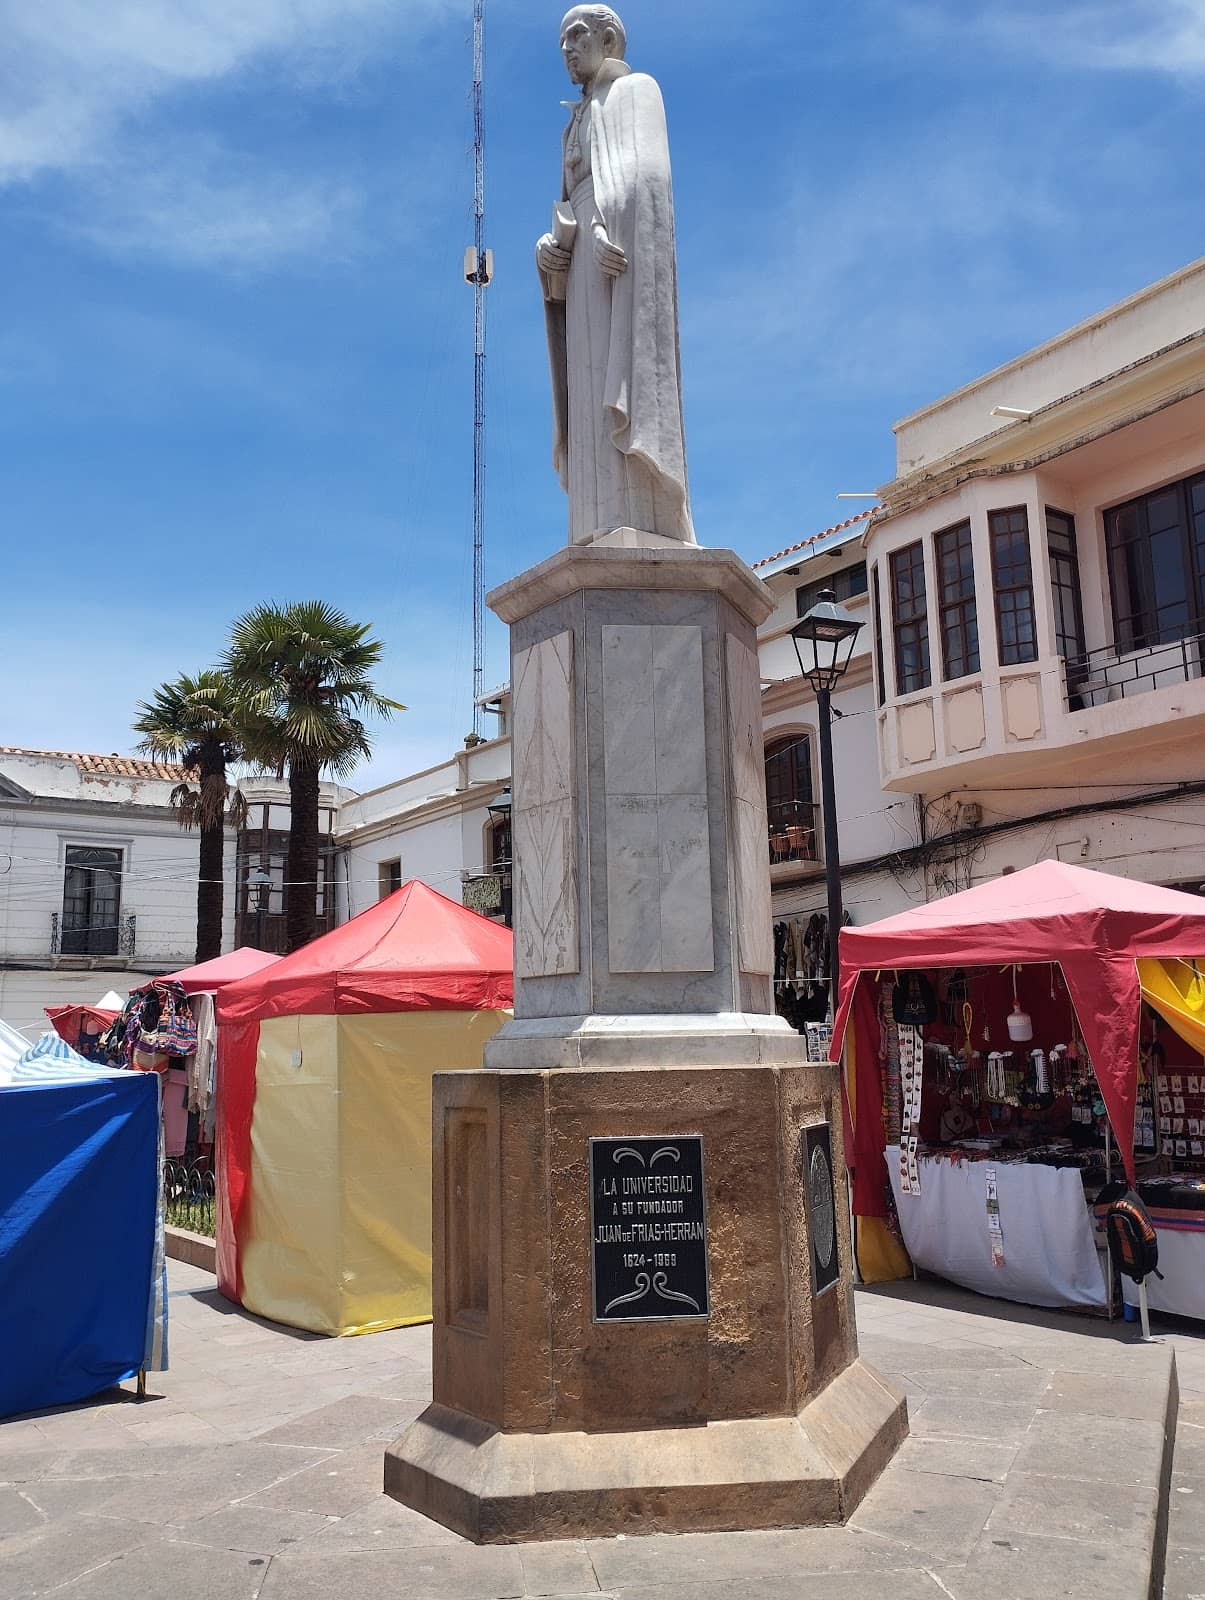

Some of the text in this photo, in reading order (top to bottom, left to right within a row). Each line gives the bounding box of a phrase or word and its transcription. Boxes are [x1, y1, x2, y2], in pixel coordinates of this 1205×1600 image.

[603, 1175, 693, 1195] LA UNIVERSIDAD
[613, 1200, 683, 1215] A SU FUNDADOR
[595, 1225, 621, 1243] JUAN
